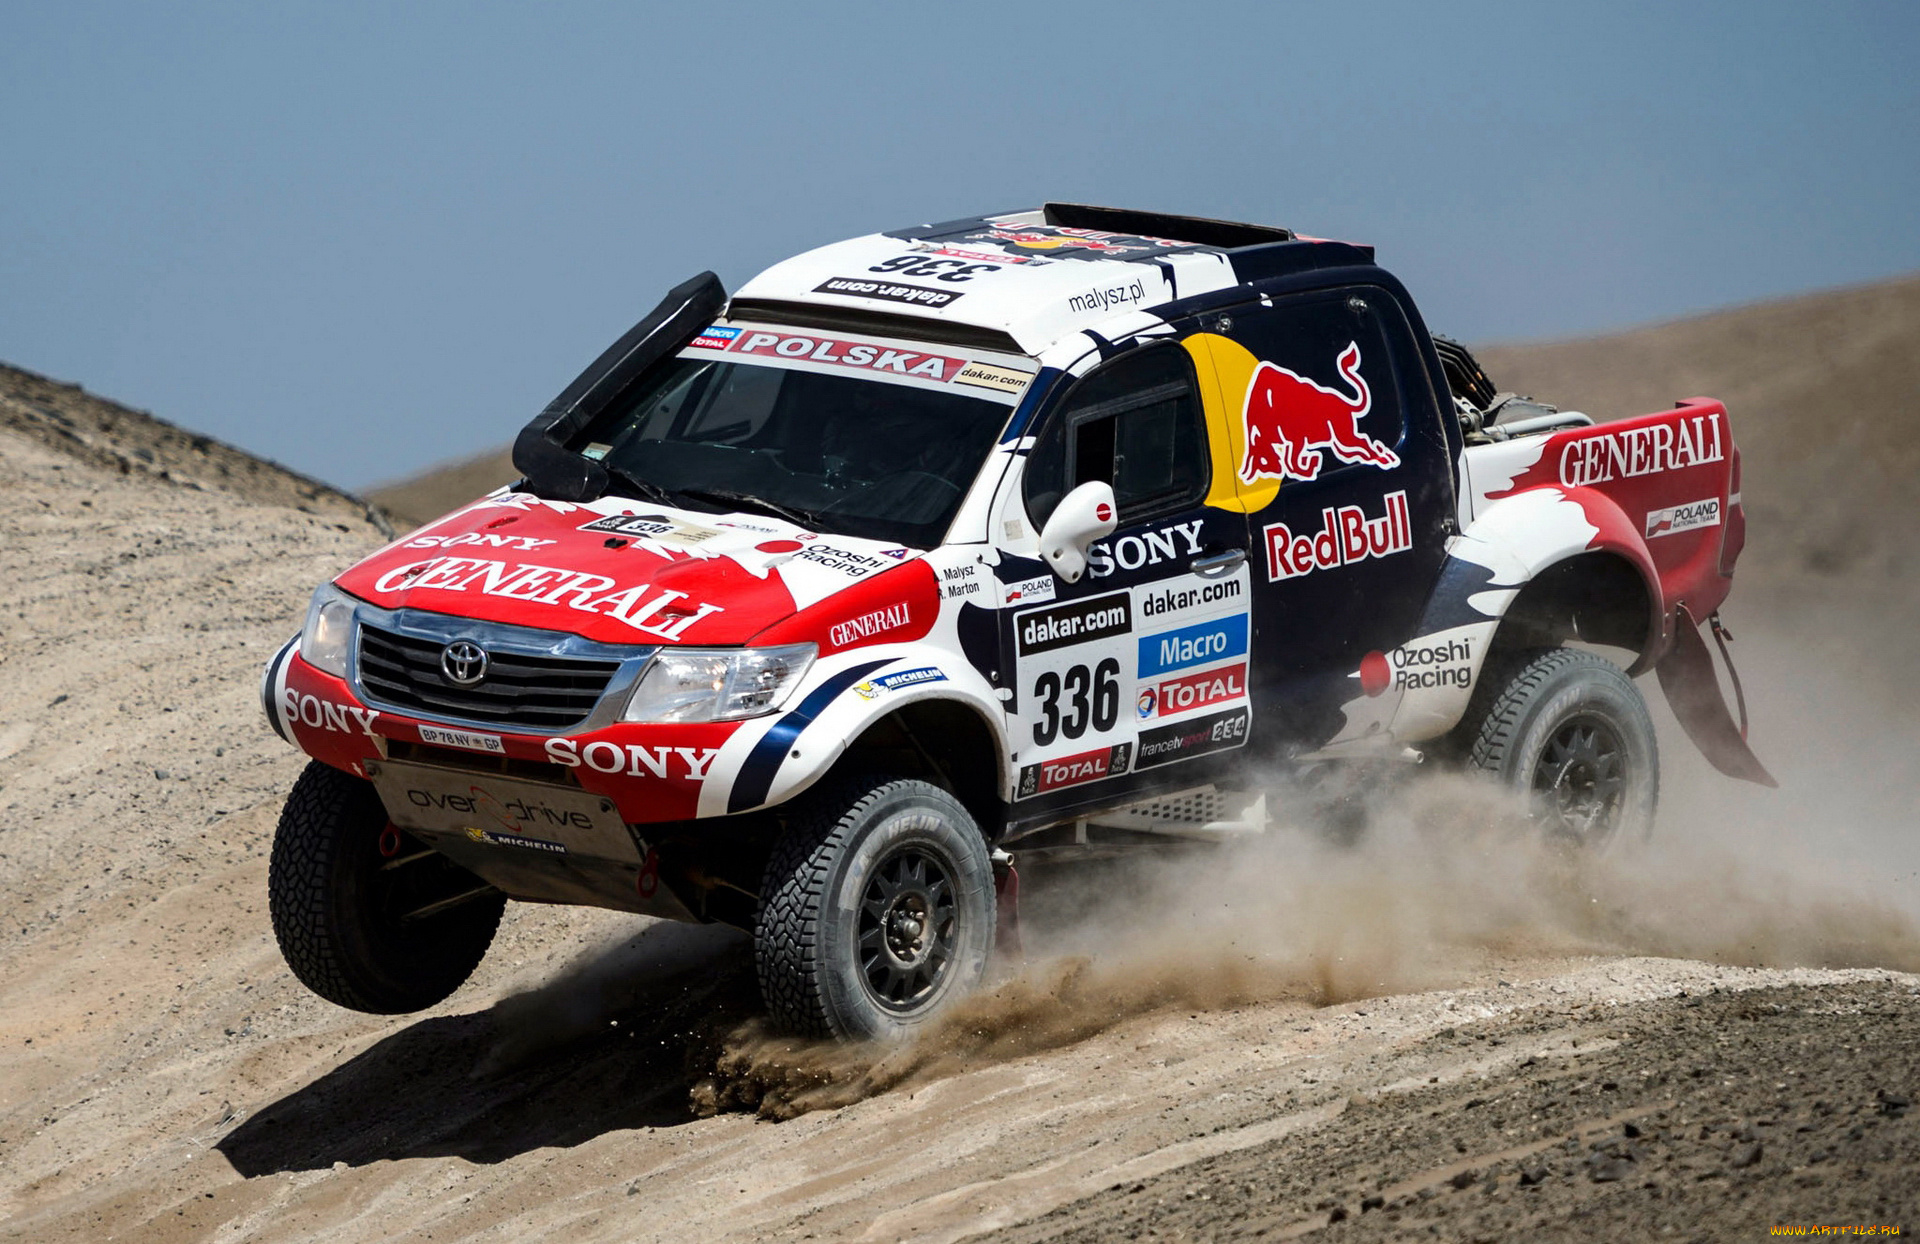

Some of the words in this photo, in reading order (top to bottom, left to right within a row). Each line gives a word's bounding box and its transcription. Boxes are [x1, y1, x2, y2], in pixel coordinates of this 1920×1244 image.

[868, 255, 1003, 282] 336
[827, 280, 951, 304] dakar.com
[1068, 279, 1146, 312] malysz.pl
[741, 333, 950, 381] POLSKA
[961, 369, 1027, 387] dakar.com
[1560, 413, 1724, 488] GENERALI
[1674, 502, 1718, 522] POLAND
[1700, 514, 1716, 522] TEAM
[627, 521, 675, 534] 336
[403, 532, 557, 551] SONY
[1087, 518, 1204, 579] SONY
[792, 550, 869, 577] Racing
[807, 545, 888, 568] Ozoshi
[943, 565, 975, 581] Malysz
[1022, 578, 1053, 592] POLAND
[375, 556, 725, 641] GENERALI
[948, 582, 980, 598] Marton
[1143, 579, 1240, 617] dakar.com
[830, 602, 911, 647] GENERALI
[1024, 606, 1125, 645] dakar.com
[1160, 632, 1227, 666] Macro
[1393, 638, 1470, 669] Ozoshi
[884, 667, 942, 687] MICHELIN
[1395, 665, 1471, 692] Racing
[1033, 657, 1120, 747] 336
[1163, 675, 1242, 709] TOTAL
[284, 687, 380, 737] SONY
[422, 729, 437, 742] BP
[455, 734, 471, 746] NY
[484, 738, 500, 750] GP
[544, 737, 720, 781] SONY
[1043, 761, 1106, 784] TOTAL
[497, 835, 566, 853] MICHELIN
